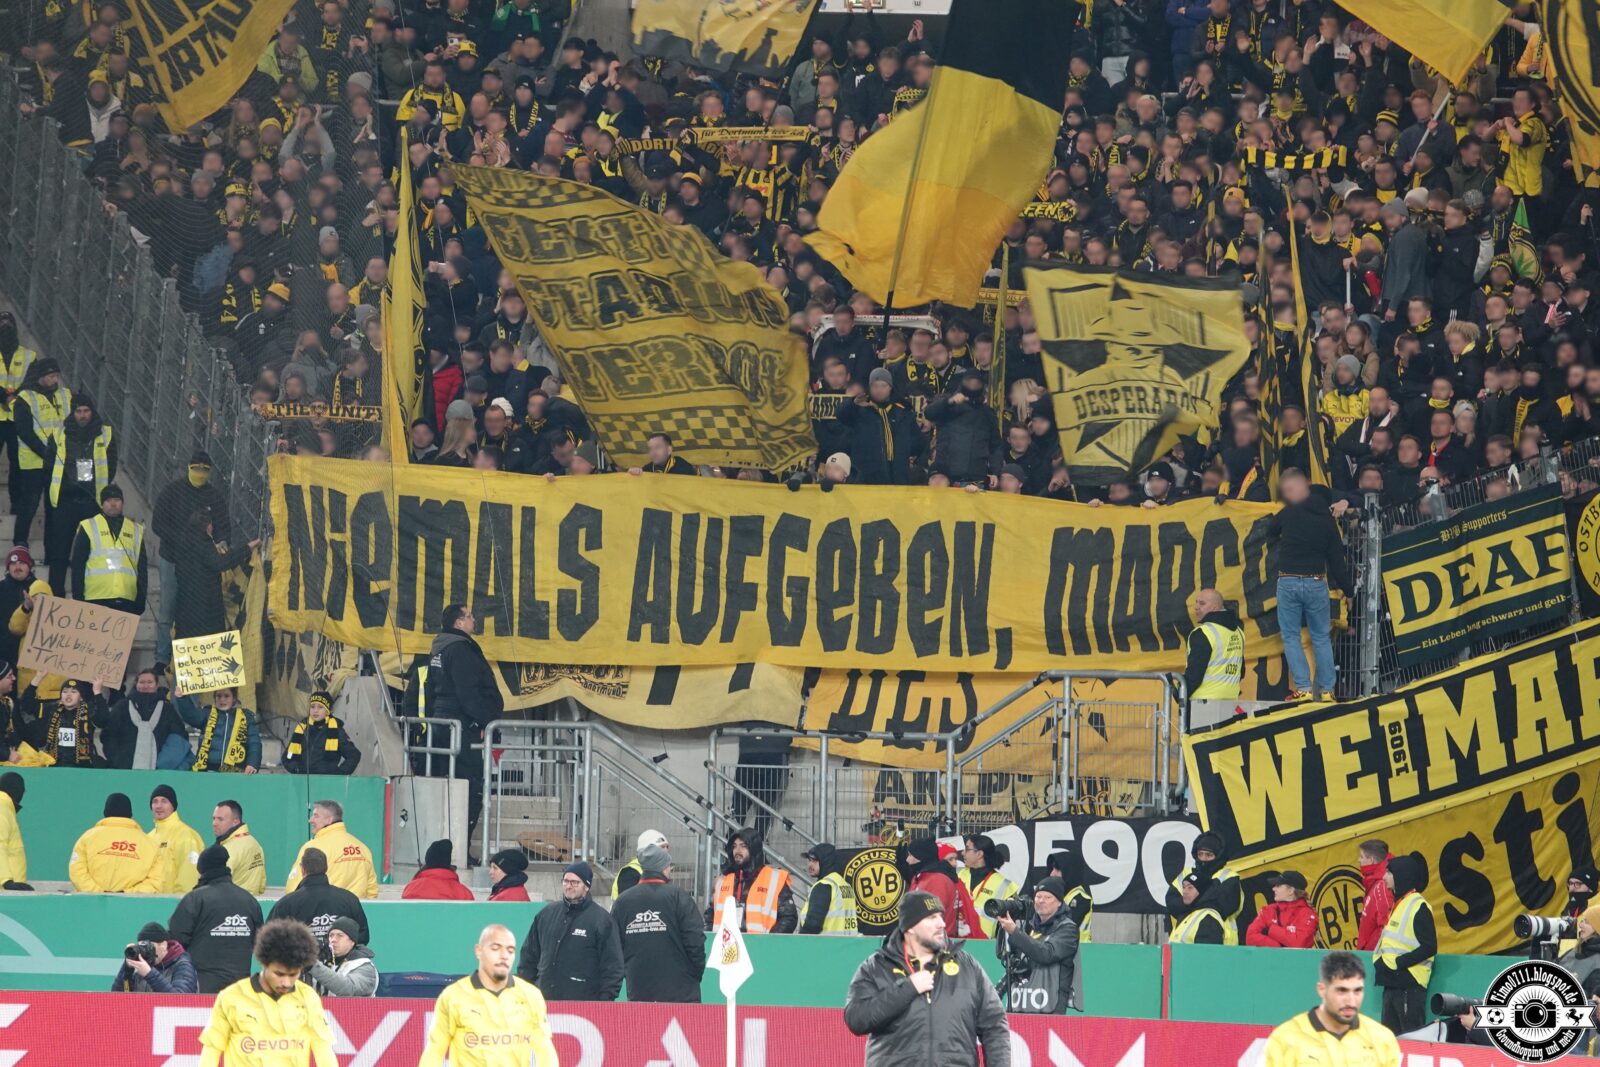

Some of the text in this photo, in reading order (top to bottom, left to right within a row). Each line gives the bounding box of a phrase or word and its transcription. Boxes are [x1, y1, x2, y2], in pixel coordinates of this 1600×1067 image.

[634, 138, 677, 151] DORT
[1391, 525, 1566, 625] DEAF
[1421, 635, 1439, 649] Ein
[1525, 600, 1543, 614] und
[175, 642, 217, 655] Gregor
[846, 851, 897, 878] BORUSS
[860, 866, 898, 898] BVB
[874, 895, 887, 906] 09
[223, 915, 248, 926] SDS
[635, 911, 661, 923] SDS
[856, 905, 900, 922] DORTMU
[1011, 987, 1049, 1010] OTO
